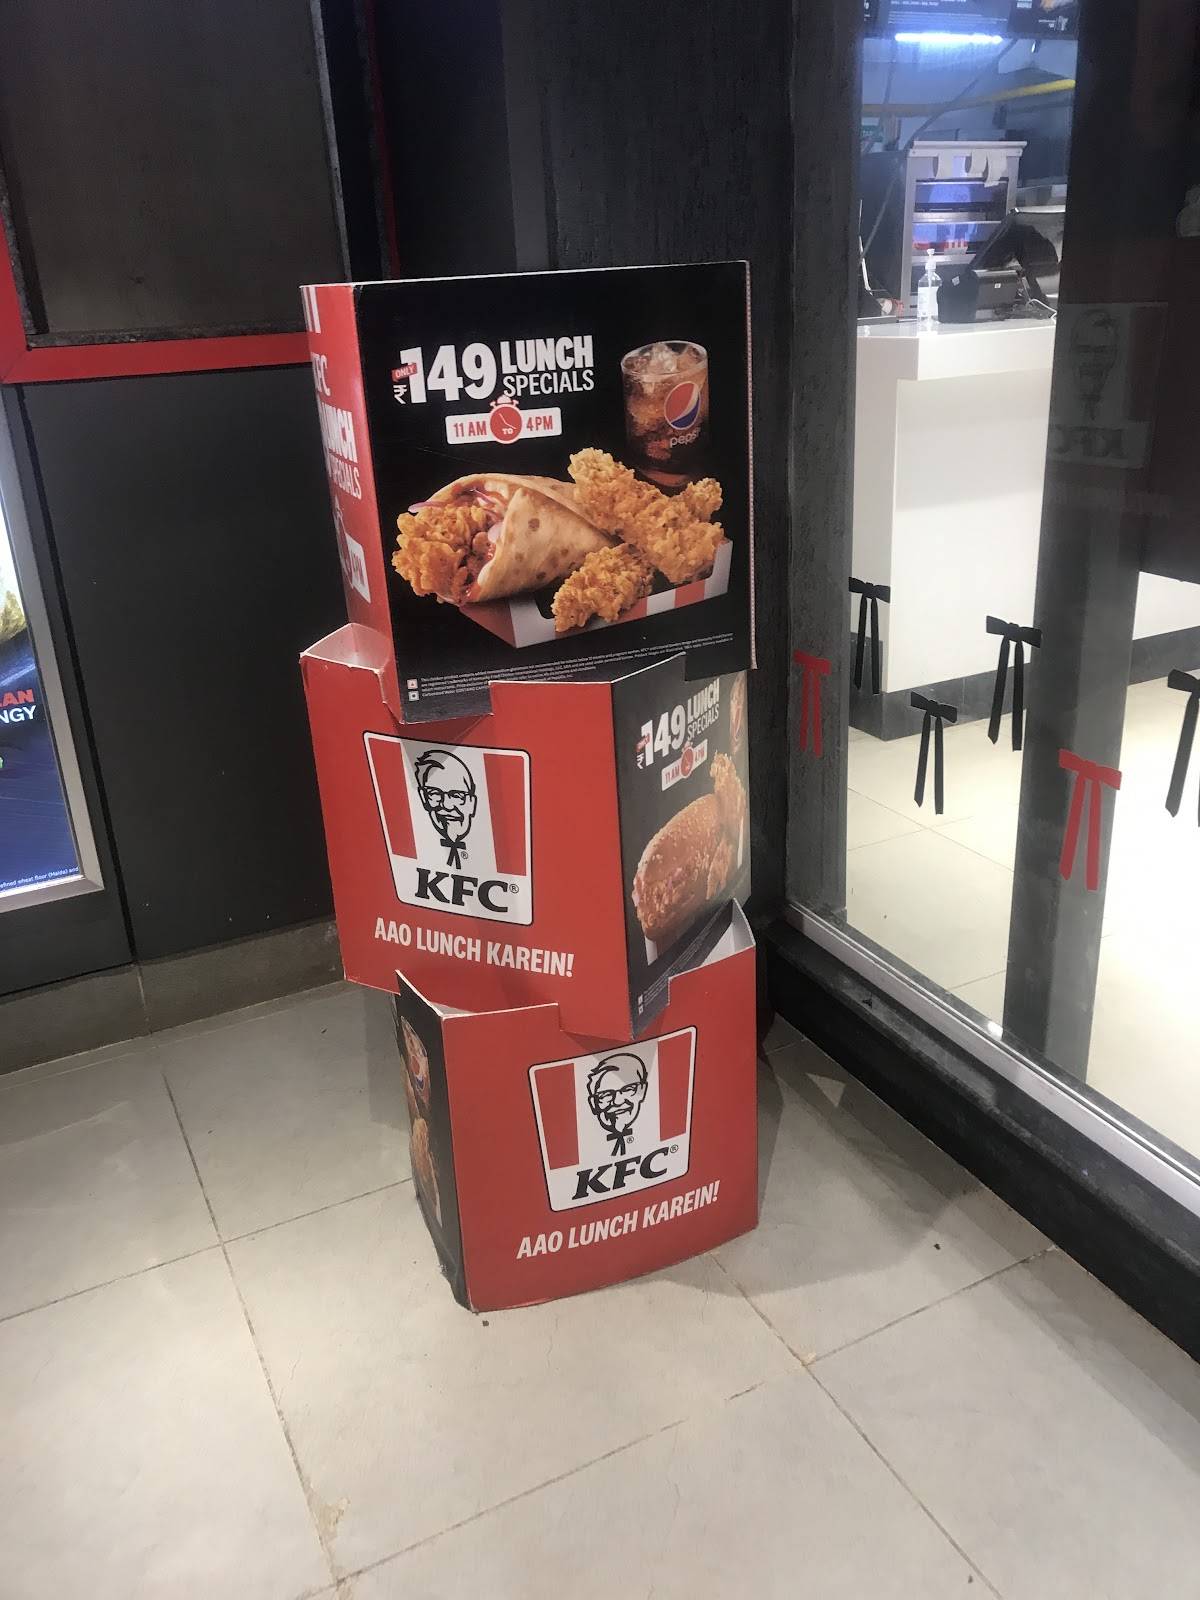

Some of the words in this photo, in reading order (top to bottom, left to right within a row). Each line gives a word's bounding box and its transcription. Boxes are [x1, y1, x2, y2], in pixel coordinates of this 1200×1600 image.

[501, 335, 594, 374] LUNCH
[503, 369, 595, 397] SPECIALS
[454, 423, 465, 438] 11
[468, 421, 488, 437] AM
[0, 689, 34, 707] AN
[687, 677, 720, 725] LUNCH
[687, 703, 720, 741] SPECIALS
[374, 917, 412, 947] AAO
[416, 927, 481, 962] LUNCH
[486, 942, 575, 978] KAREIN!
[516, 1231, 563, 1259] AAO
[567, 1211, 638, 1249] LUNCH
[642, 1180, 721, 1229] KAREIN!
